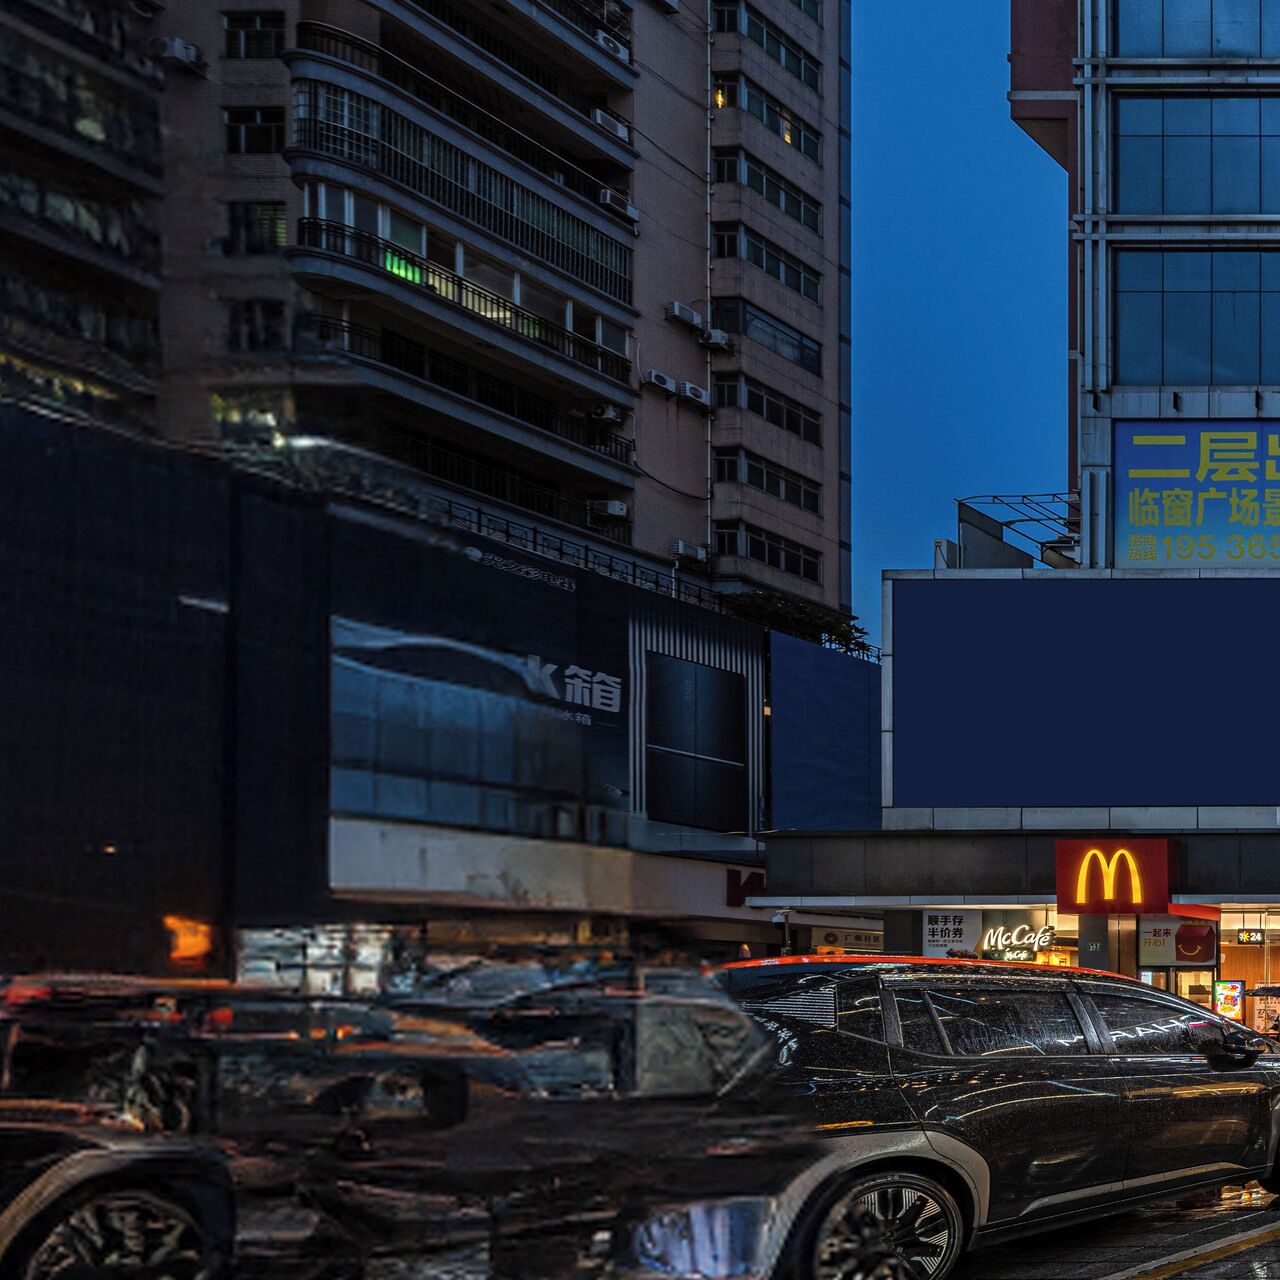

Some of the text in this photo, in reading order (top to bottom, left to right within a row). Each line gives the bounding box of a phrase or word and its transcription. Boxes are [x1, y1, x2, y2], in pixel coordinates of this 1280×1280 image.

[1163, 534, 1215, 560] 195
[927, 915, 964, 926] 顺手存
[927, 928, 964, 939] 半价券
[983, 924, 1051, 952] McCafé
[1143, 928, 1172, 938] 一起来
[1250, 932, 1262, 941] 24
